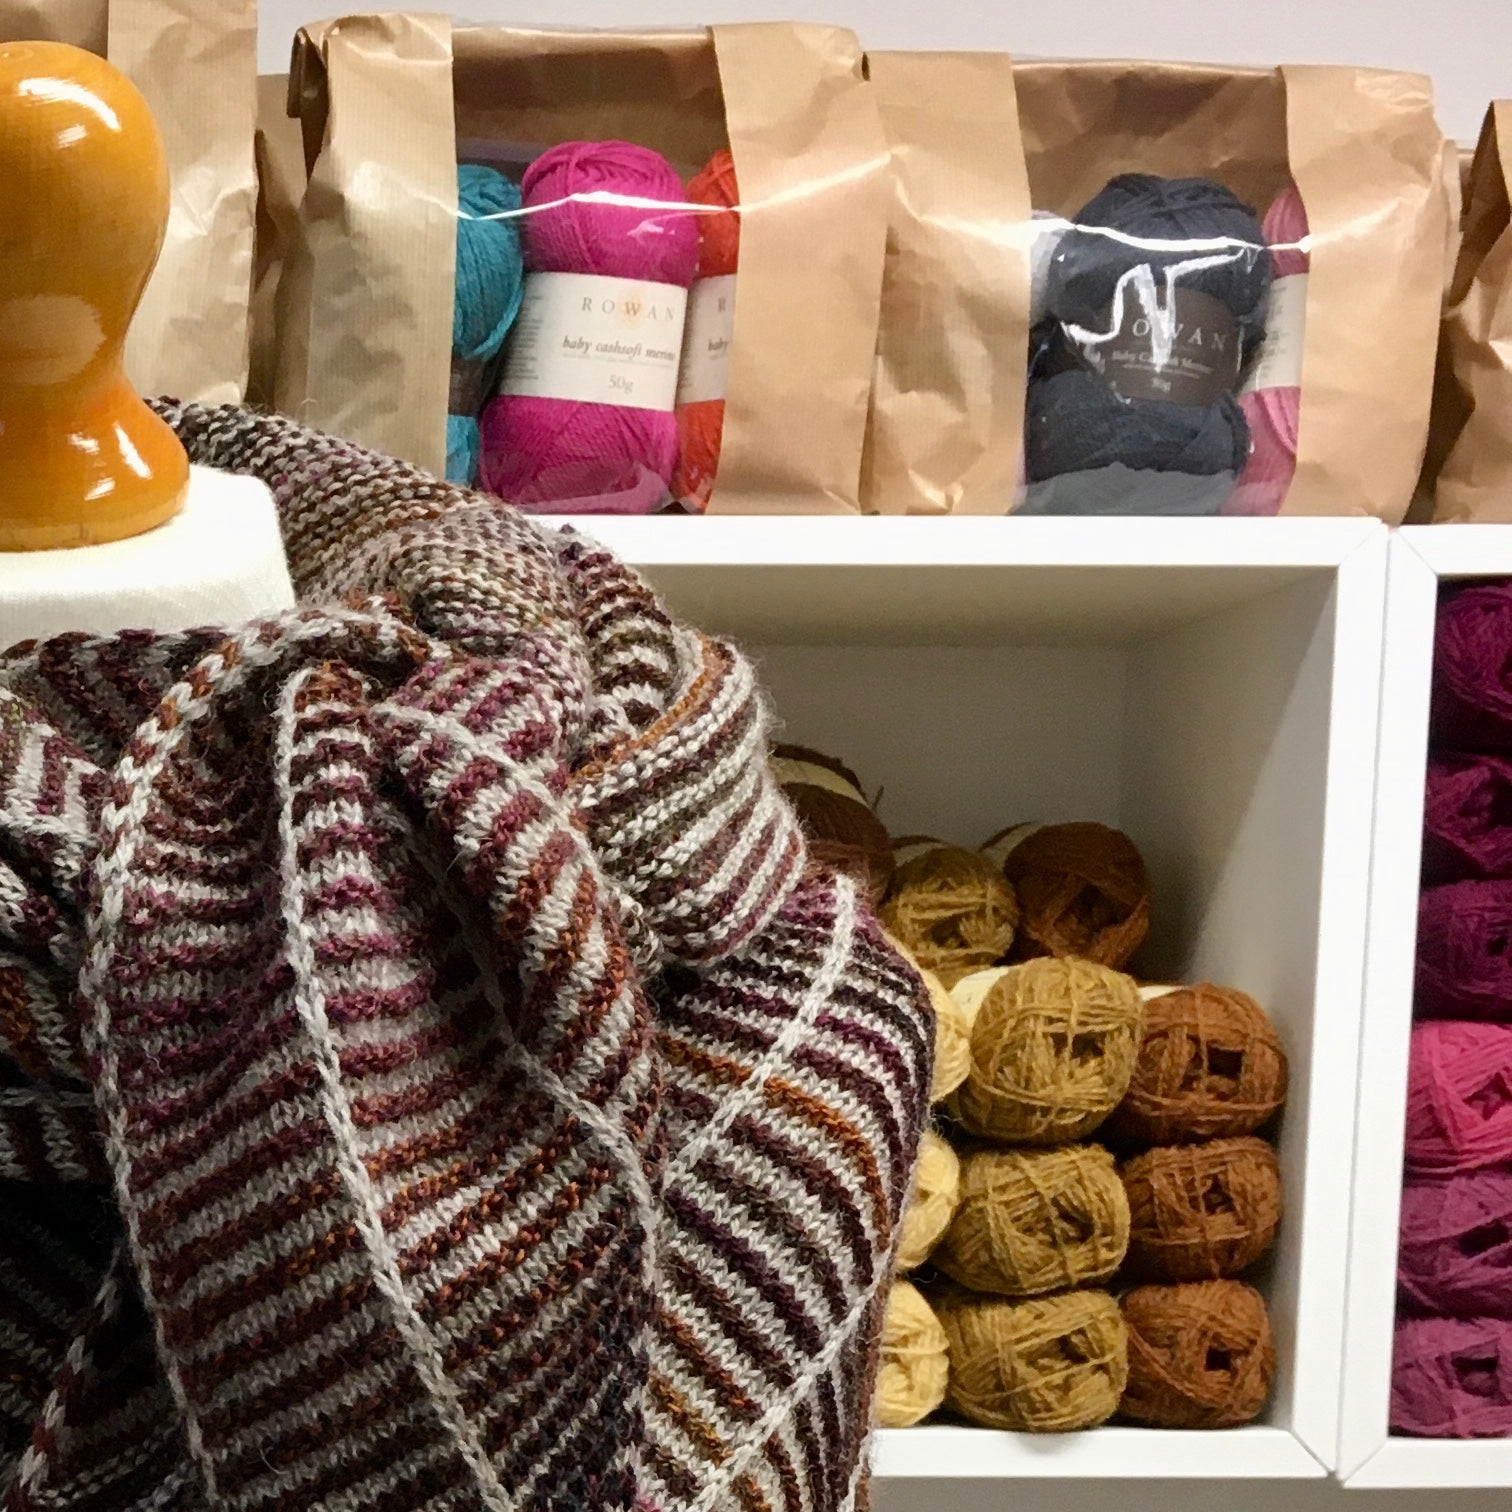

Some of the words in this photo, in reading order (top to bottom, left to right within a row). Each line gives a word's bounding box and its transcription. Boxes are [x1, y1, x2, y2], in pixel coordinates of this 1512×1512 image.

[582, 297, 675, 320] ROWAN
[1131, 318, 1226, 351] OAN
[562, 335, 592, 354] baby
[595, 340, 642, 358] cashsoft
[608, 374, 634, 394] 50g
